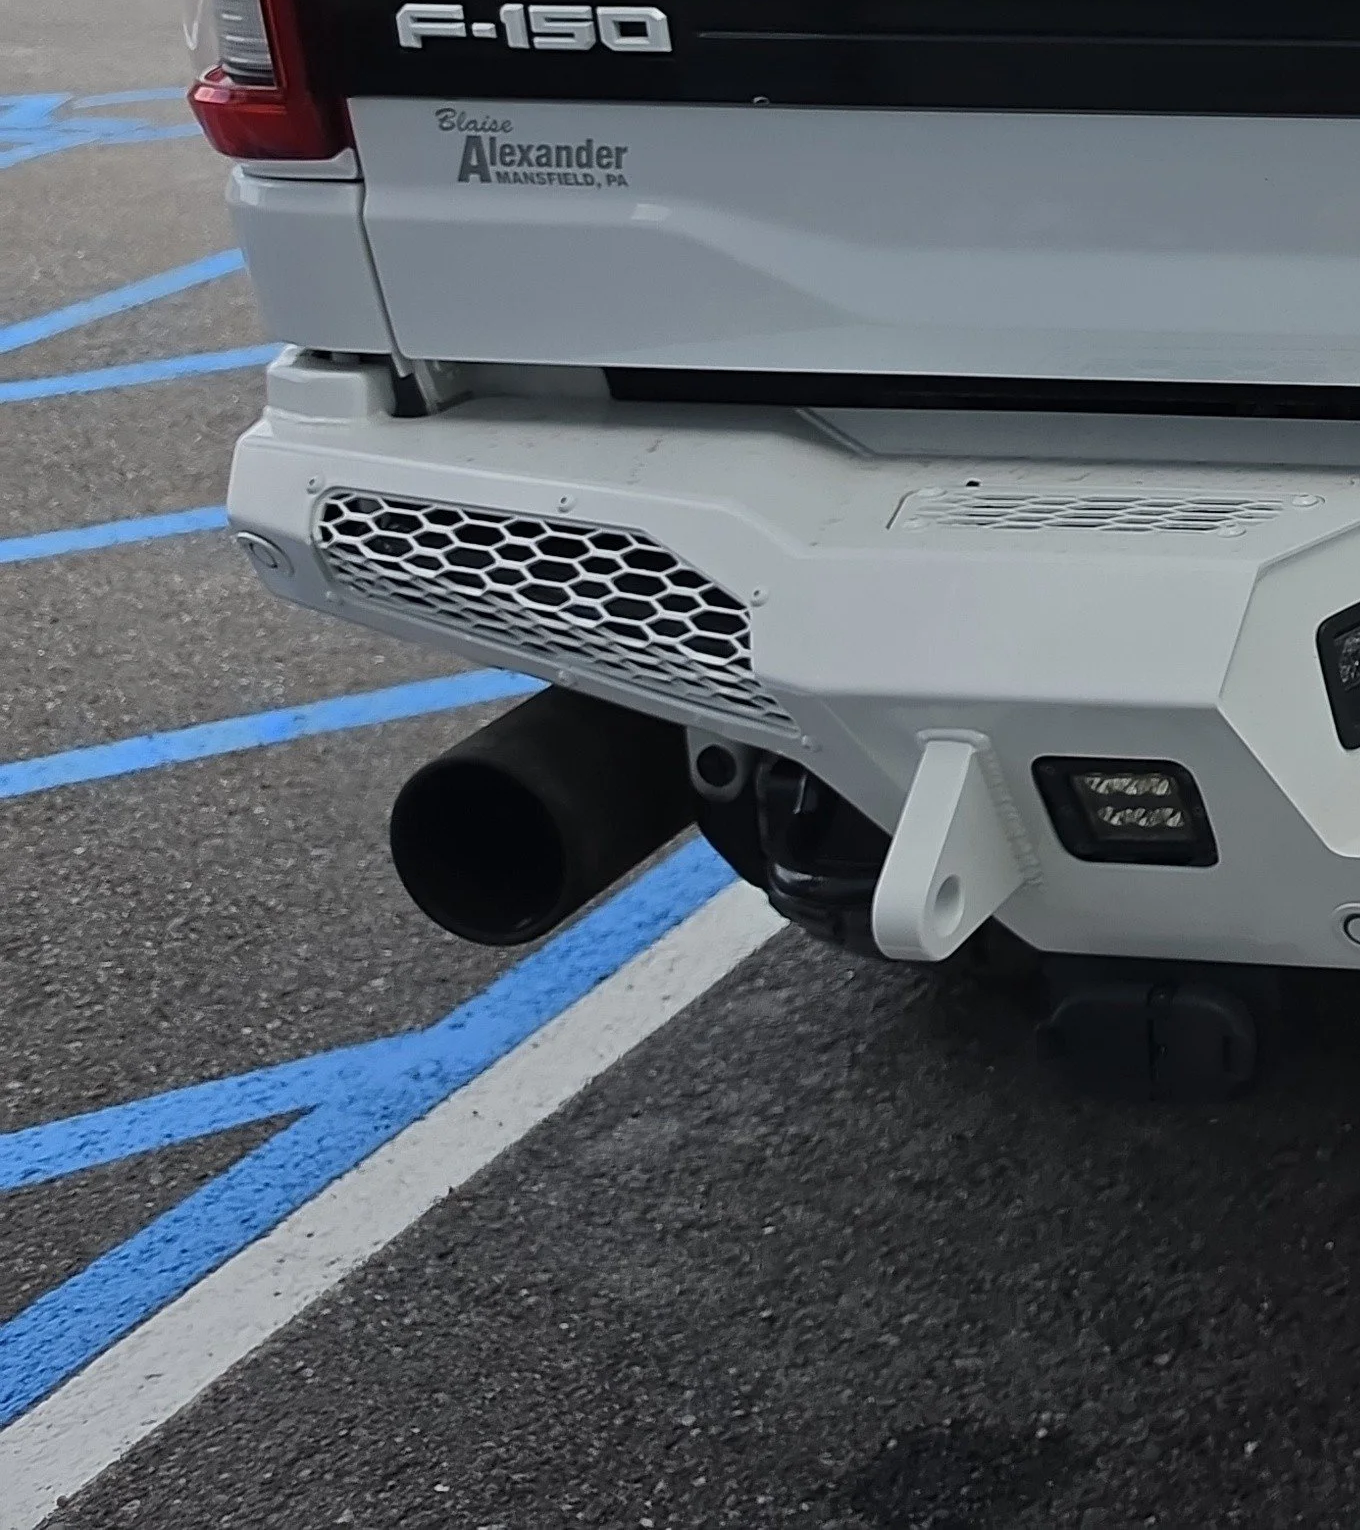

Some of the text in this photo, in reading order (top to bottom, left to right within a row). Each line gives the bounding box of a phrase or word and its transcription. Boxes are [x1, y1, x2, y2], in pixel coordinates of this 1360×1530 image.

[394, 2, 673, 53] F-150
[434, 107, 514, 134] Blaise
[457, 134, 629, 184] Alexander
[494, 170, 630, 190] MANSFIELD, PA
